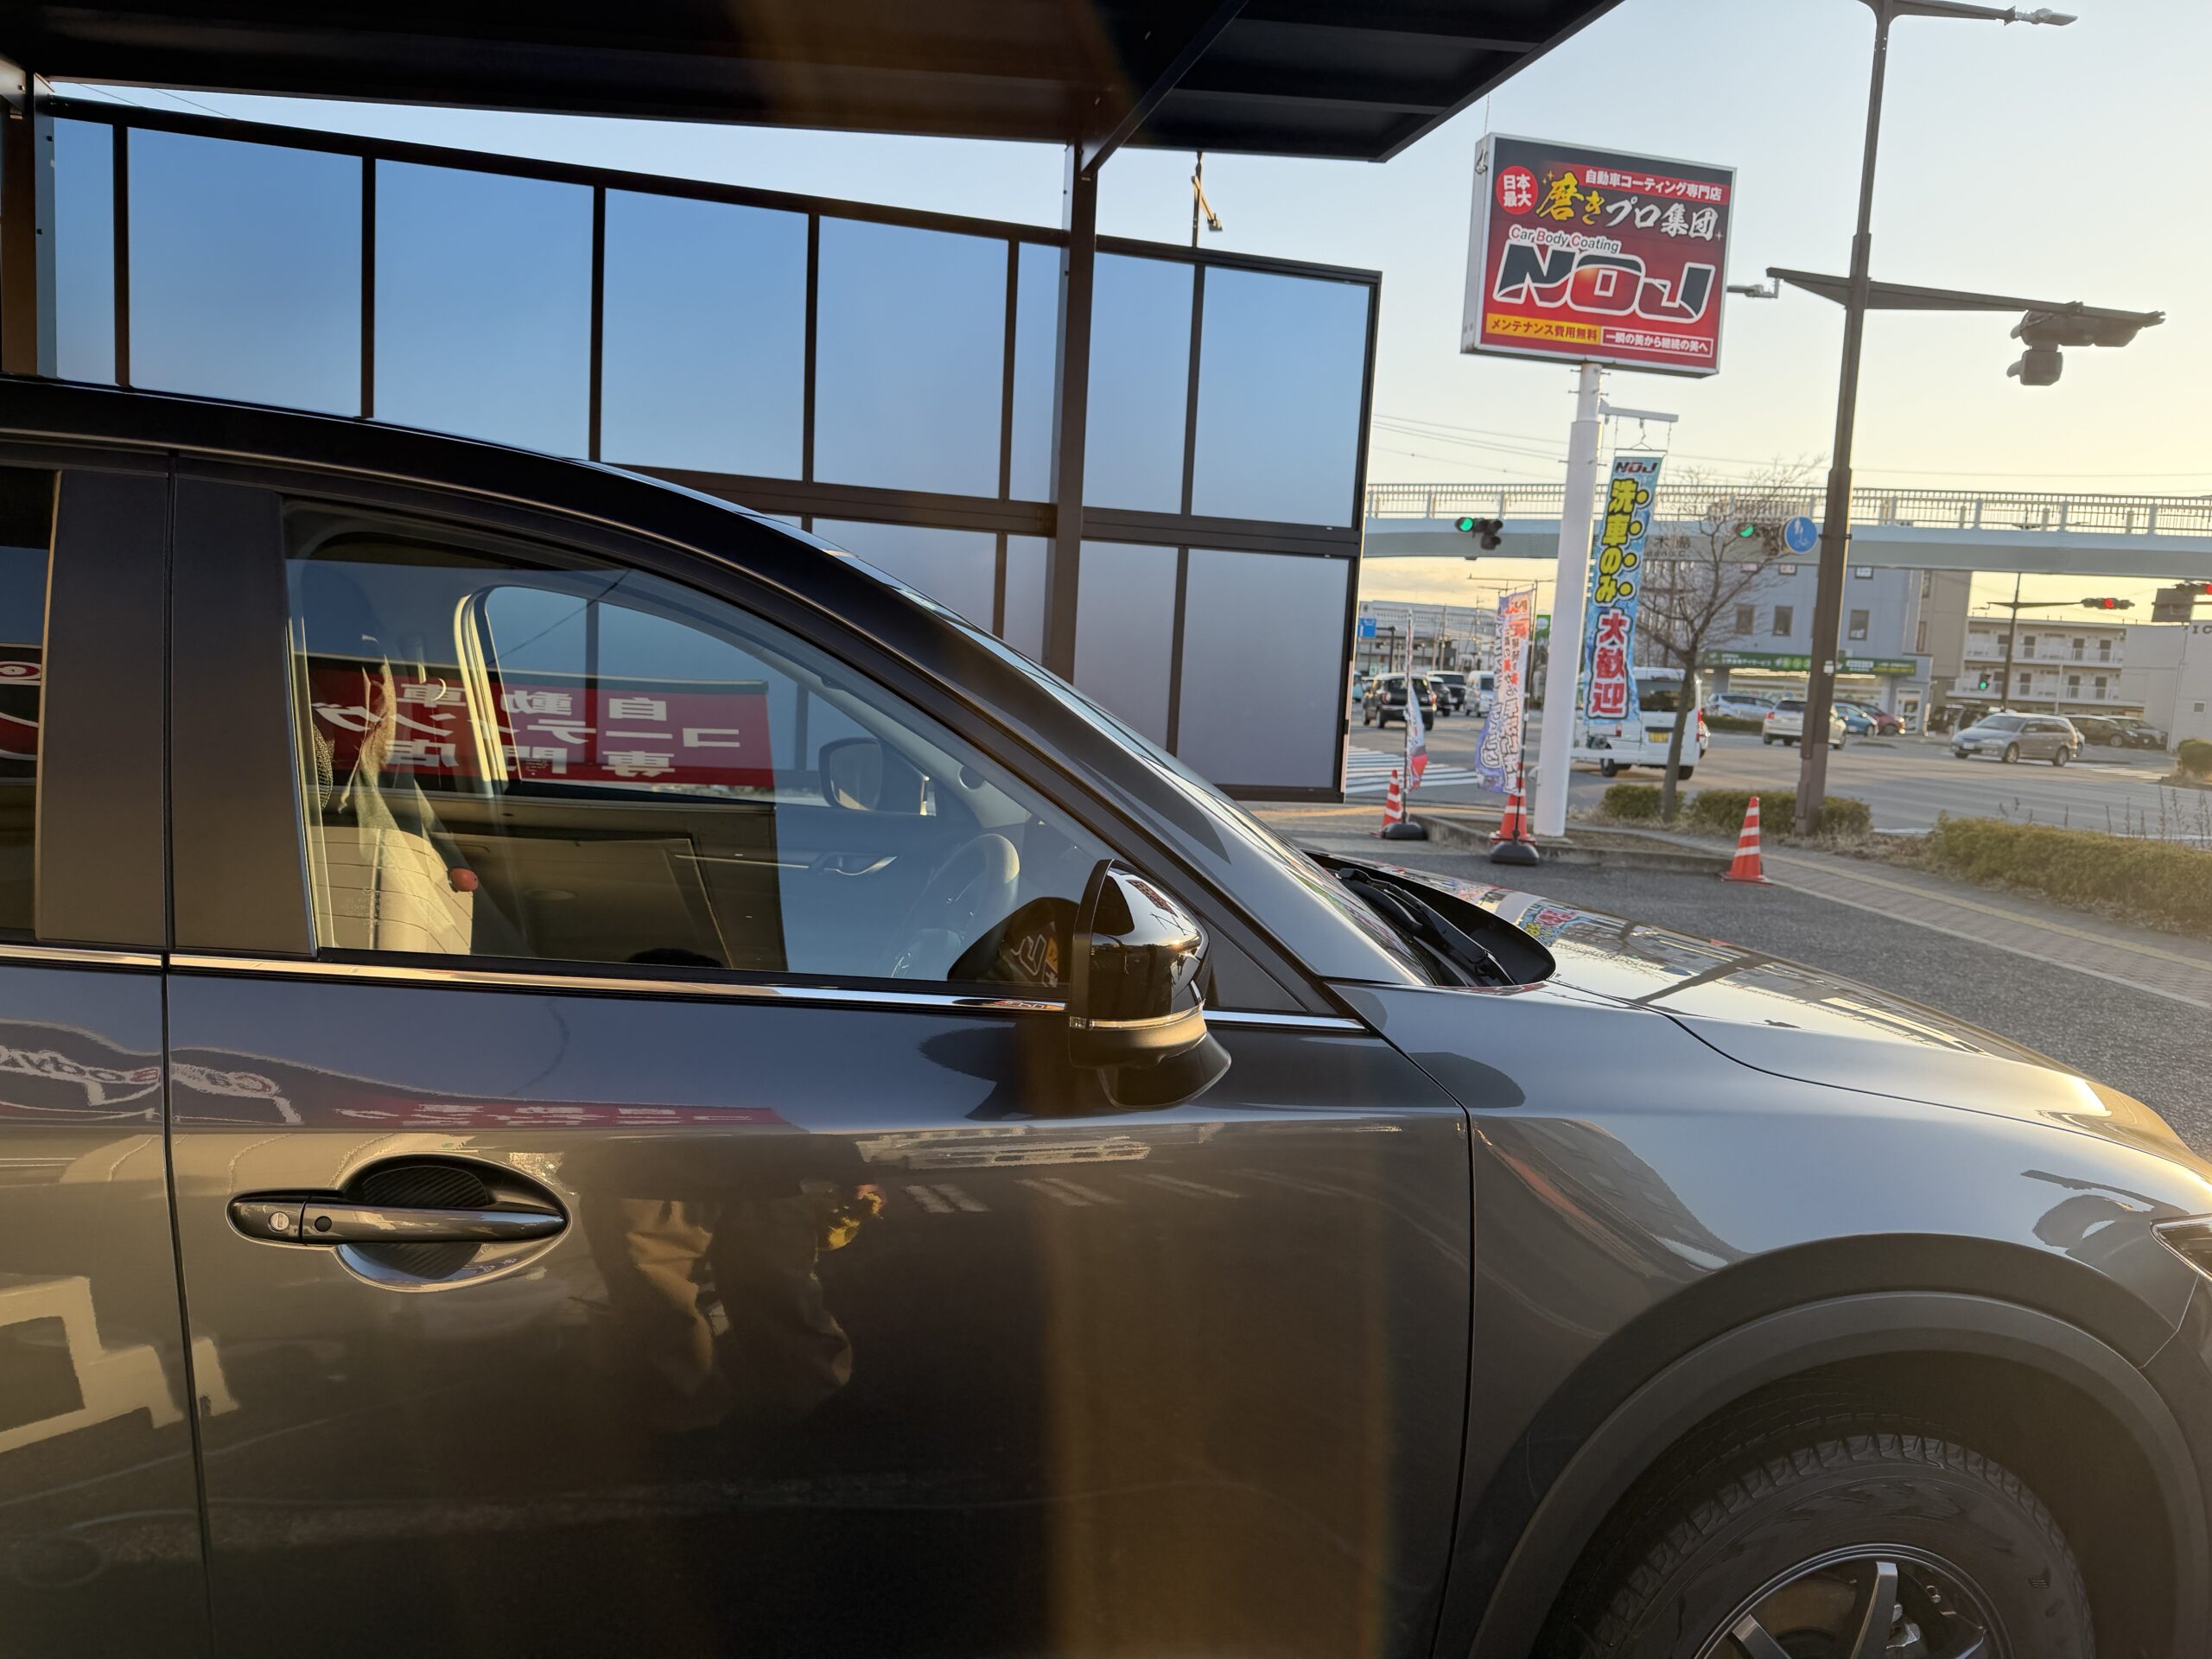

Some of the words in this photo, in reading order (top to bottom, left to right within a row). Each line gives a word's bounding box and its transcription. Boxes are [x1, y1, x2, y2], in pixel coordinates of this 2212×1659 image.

[1503, 175, 1531, 190] 日本
[1585, 168, 1723, 201] 自動車コーティング専門店
[1503, 191, 1532, 207] 最大
[1536, 171, 1719, 242] 磨きプロ集団
[1510, 226, 1534, 241] Car
[1536, 230, 1568, 248] Body
[1571, 234, 1619, 254] Coating
[1492, 239, 1716, 324] NOJ
[1490, 319, 1598, 341] メンテナンス費用無料
[1615, 461, 1658, 474] NOJ
[1594, 478, 1639, 603] 洗車のみ
[1592, 612, 1628, 715] 大歓迎
